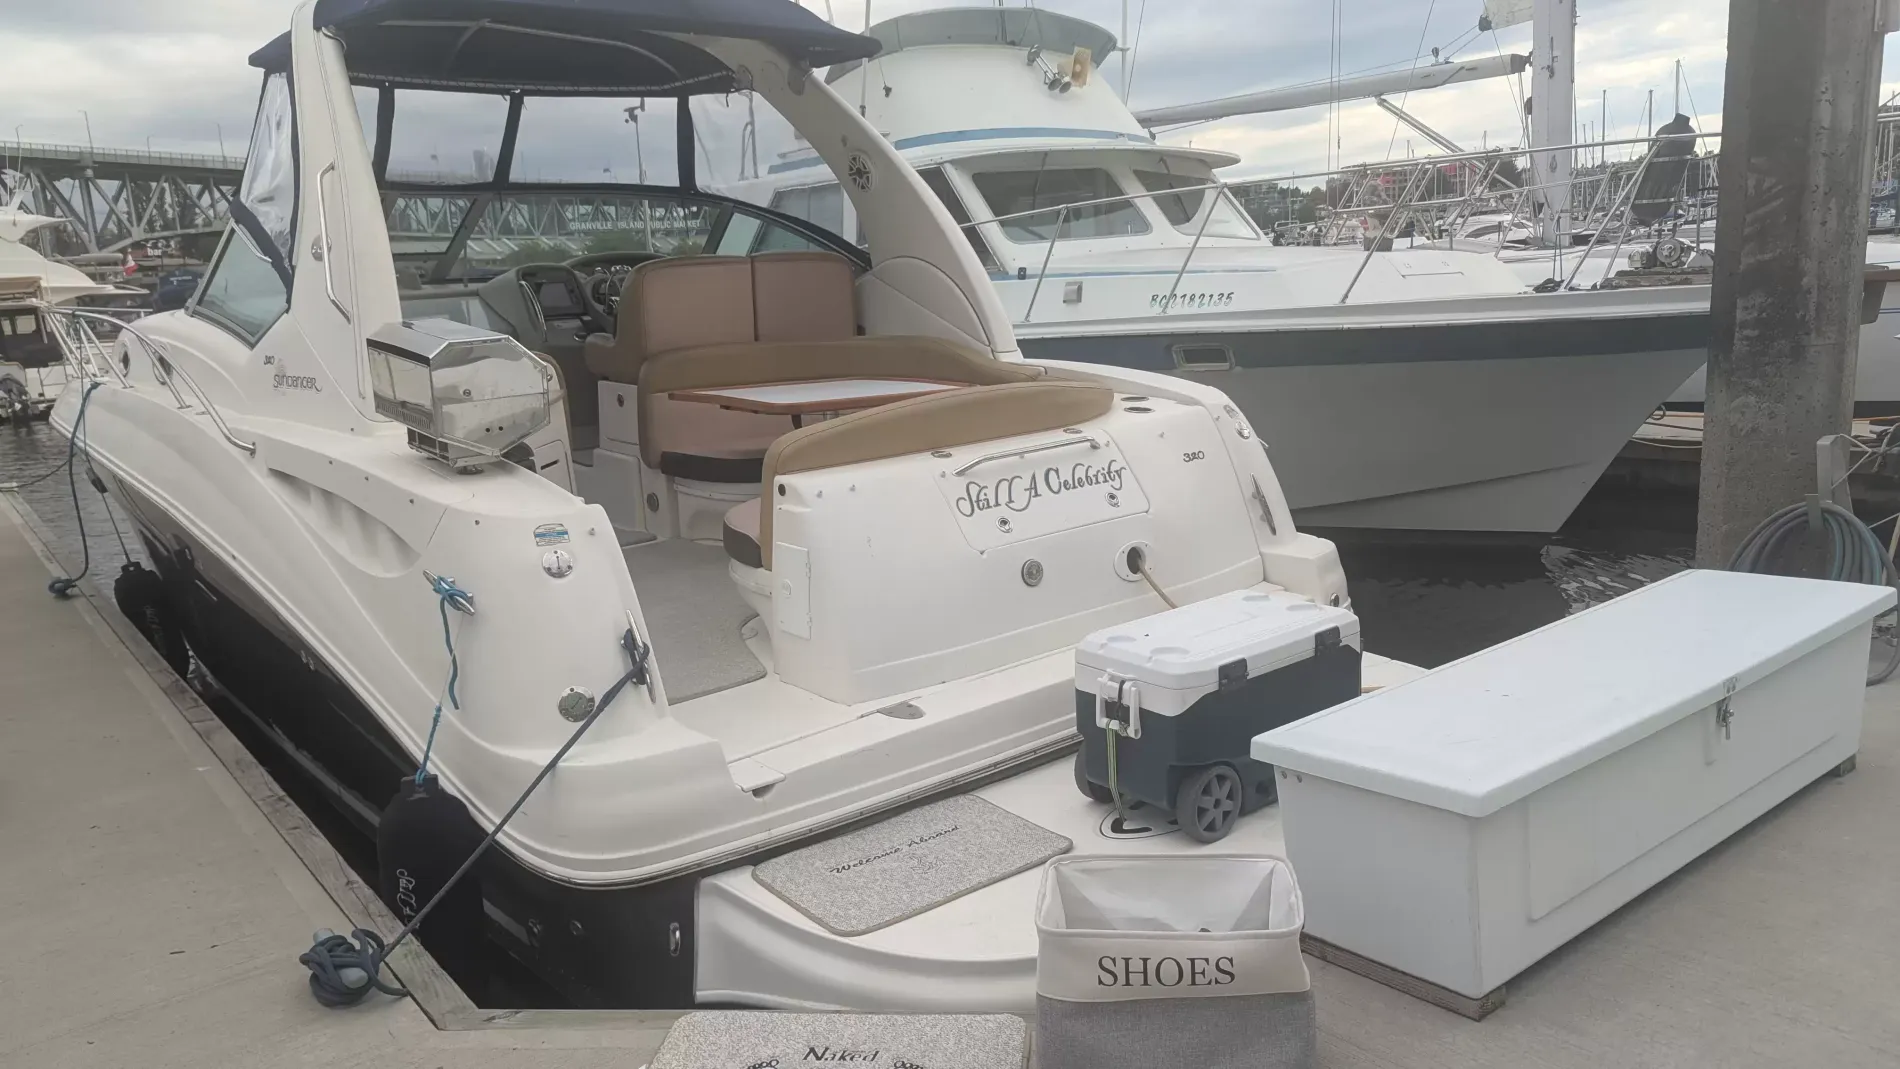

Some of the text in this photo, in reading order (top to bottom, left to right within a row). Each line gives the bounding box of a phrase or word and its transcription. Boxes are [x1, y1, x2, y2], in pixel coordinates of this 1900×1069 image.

[569, 221, 613, 231] GRANVILLE
[617, 221, 645, 230] ISLAND
[147, 247, 163, 256] bar
[1182, 450, 1205, 463] 320
[956, 475, 1022, 517] Still
[1044, 459, 1127, 495] Celebrity
[829, 825, 959, 873] Welcome Aboard
[1097, 955, 1236, 987] SHOES
[803, 1047, 880, 1062] Naked
